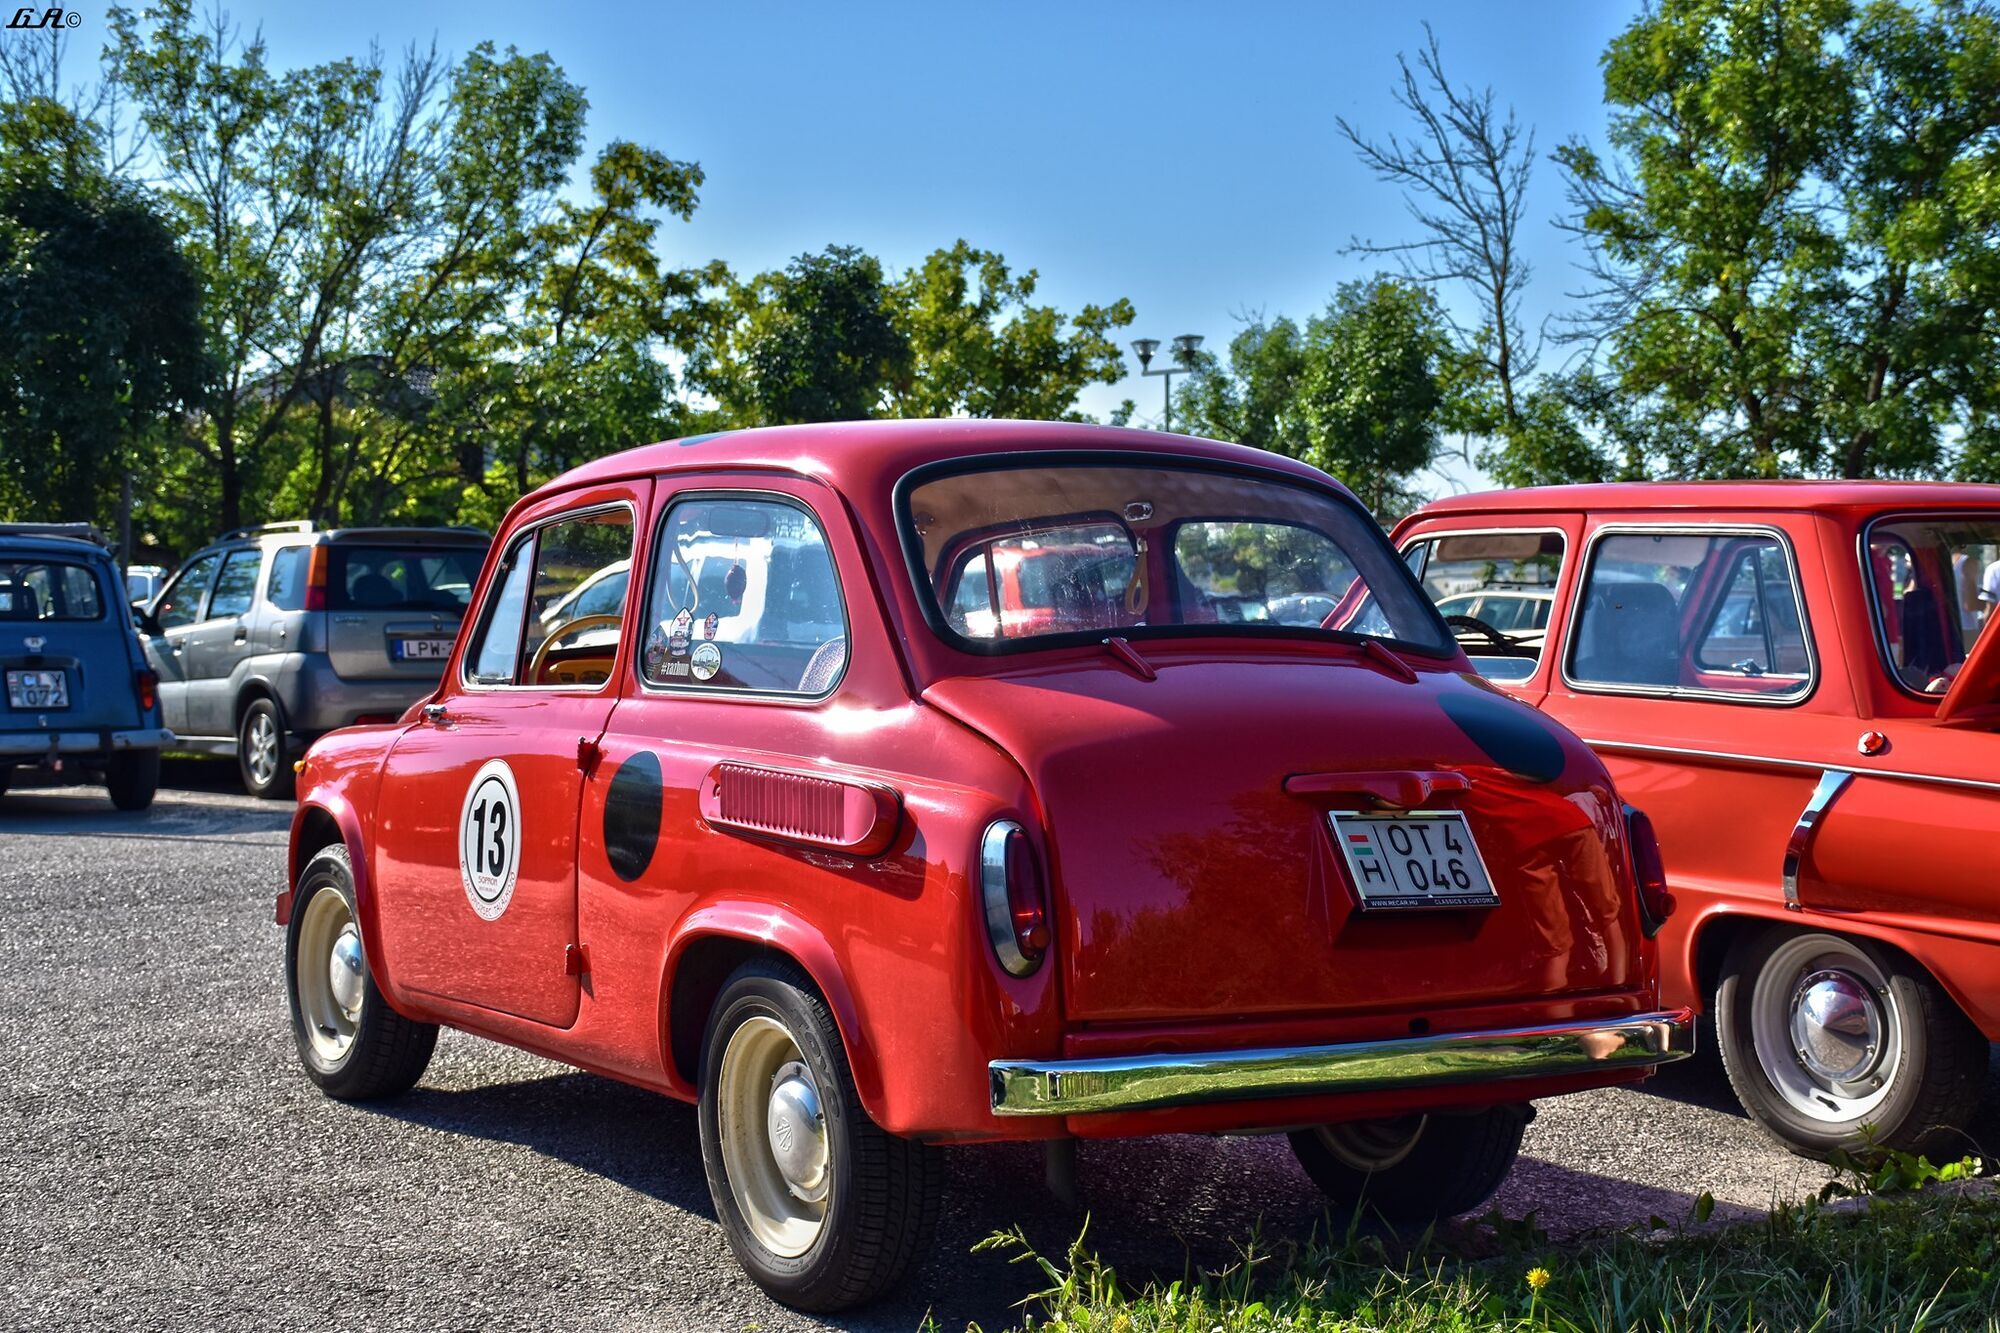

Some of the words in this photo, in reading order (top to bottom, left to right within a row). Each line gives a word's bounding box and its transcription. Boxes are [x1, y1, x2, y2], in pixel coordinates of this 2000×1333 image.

[26, 690, 64, 705] 072
[474, 799, 506, 877] 13
[1359, 859, 1386, 883] H
[1406, 858, 1471, 891] 046
